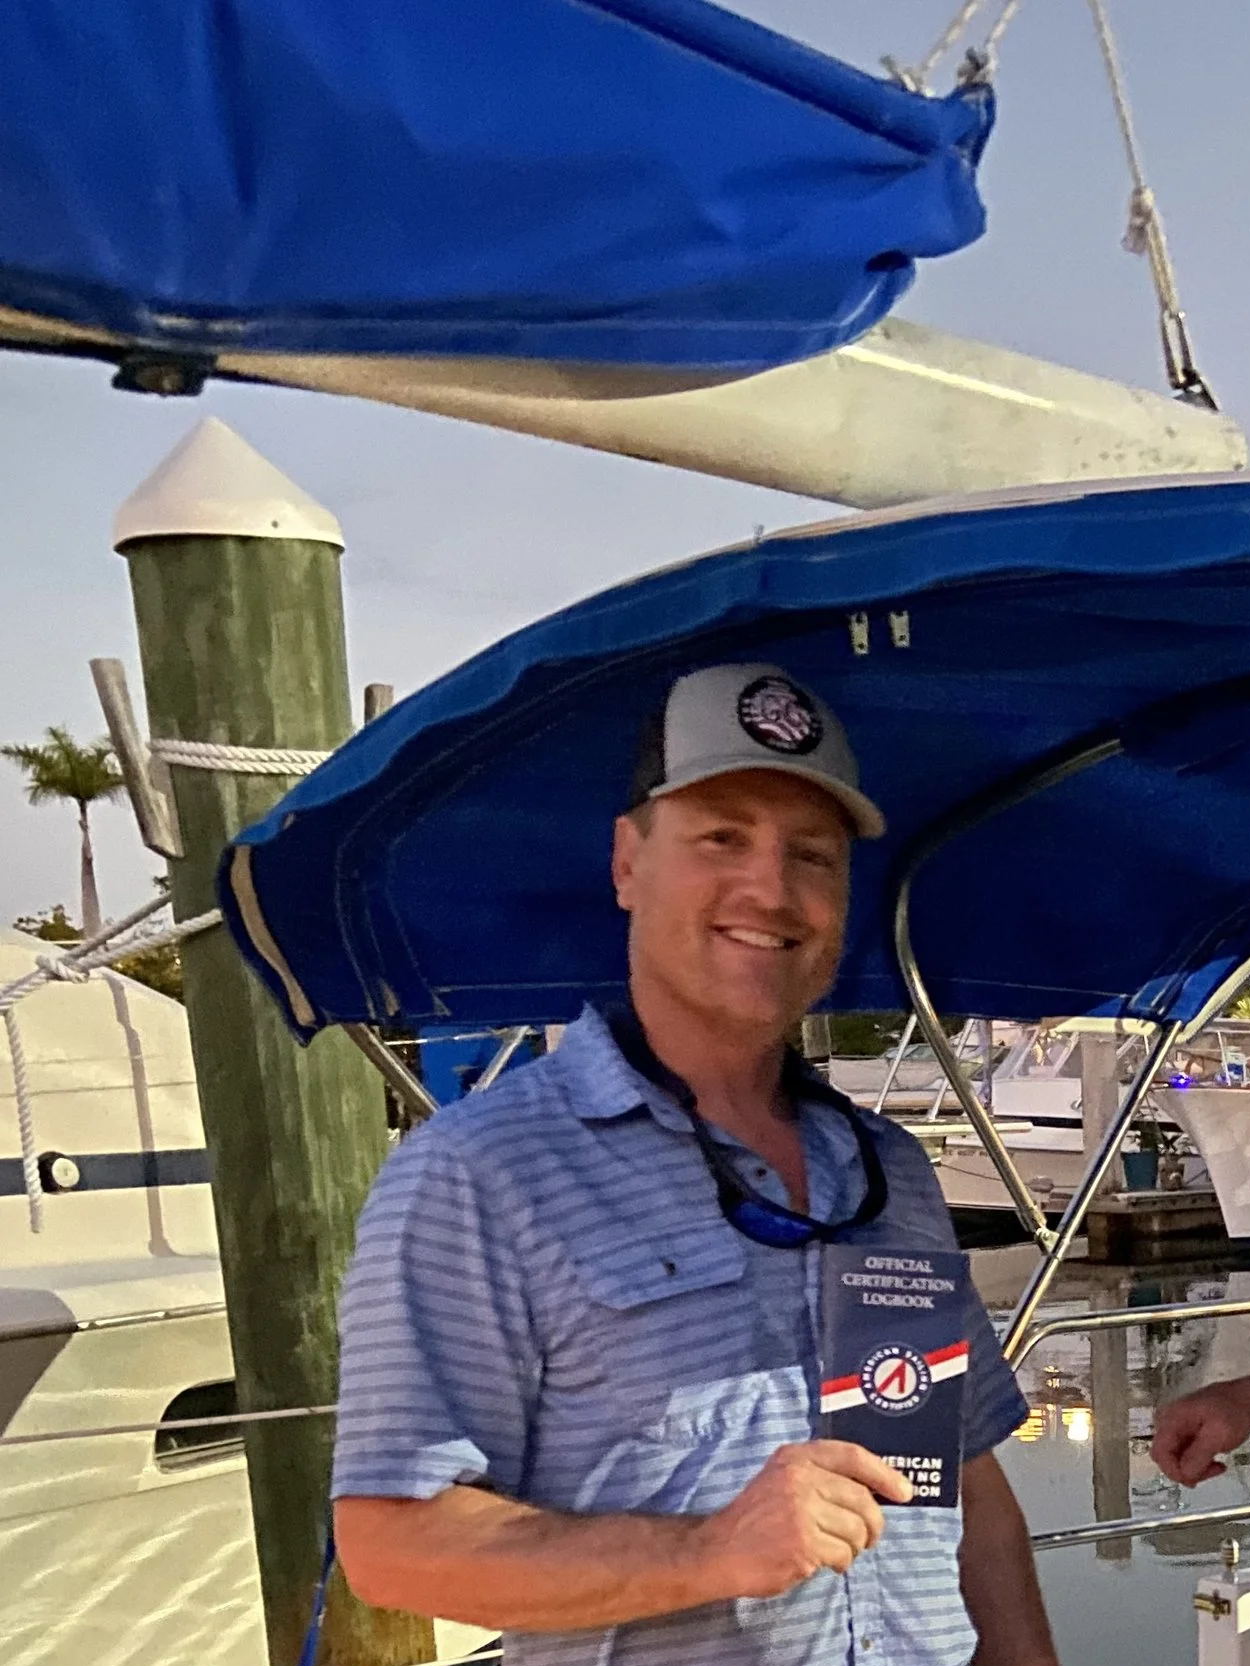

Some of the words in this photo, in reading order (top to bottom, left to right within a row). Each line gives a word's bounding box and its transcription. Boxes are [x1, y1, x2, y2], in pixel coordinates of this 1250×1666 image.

[865, 1256, 934, 1273] OFFICIAL
[841, 1273, 956, 1291] CERTIFICATION
[863, 1292, 935, 1309] LOGBOOK
[880, 1456, 943, 1469] ERICAN
